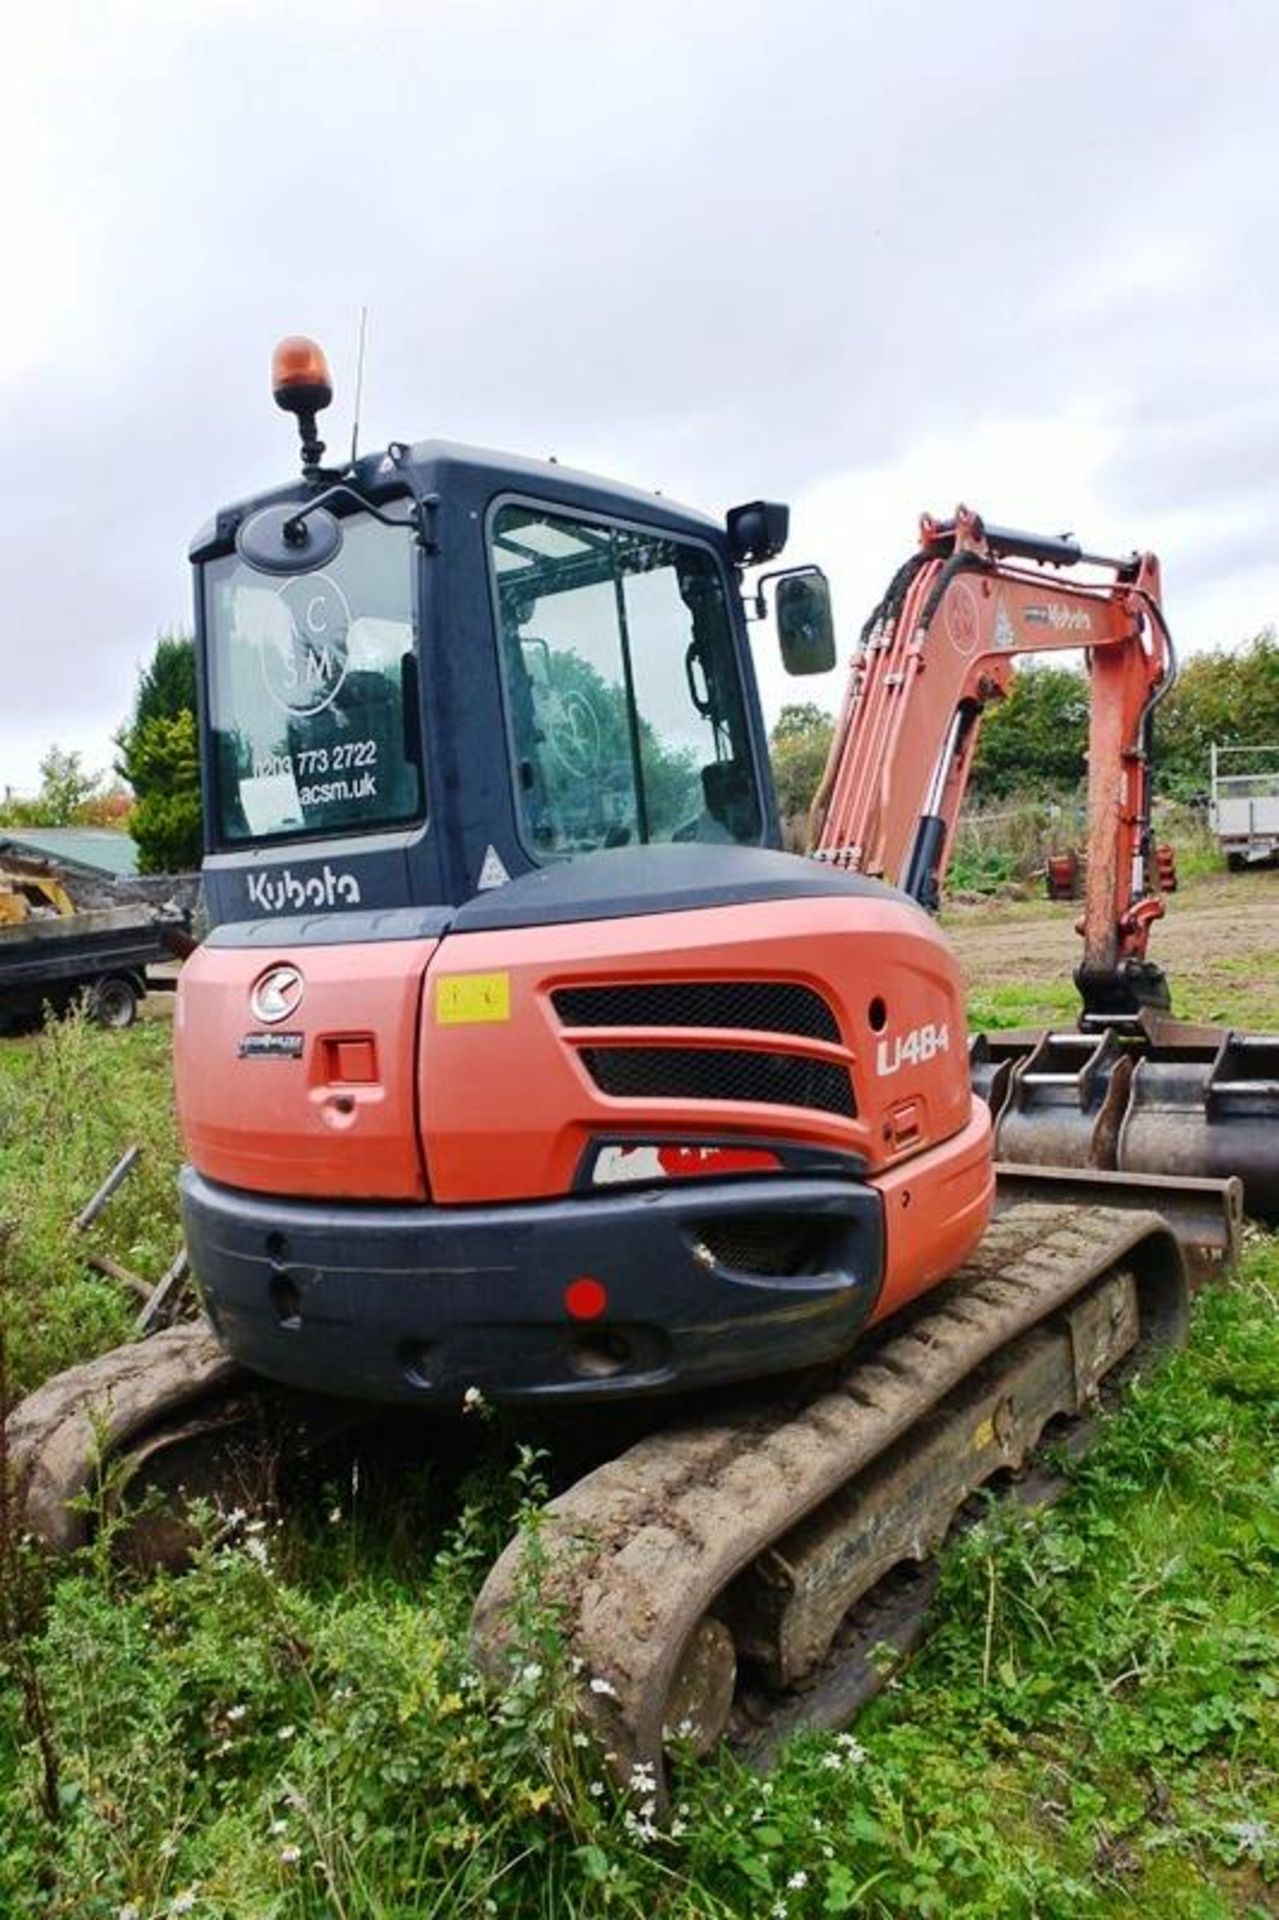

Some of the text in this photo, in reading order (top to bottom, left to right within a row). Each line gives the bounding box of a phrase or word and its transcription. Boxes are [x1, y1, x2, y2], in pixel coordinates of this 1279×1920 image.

[297, 748, 329, 775] 773
[332, 740, 377, 770] 2722
[247, 865, 361, 911] Kubota
